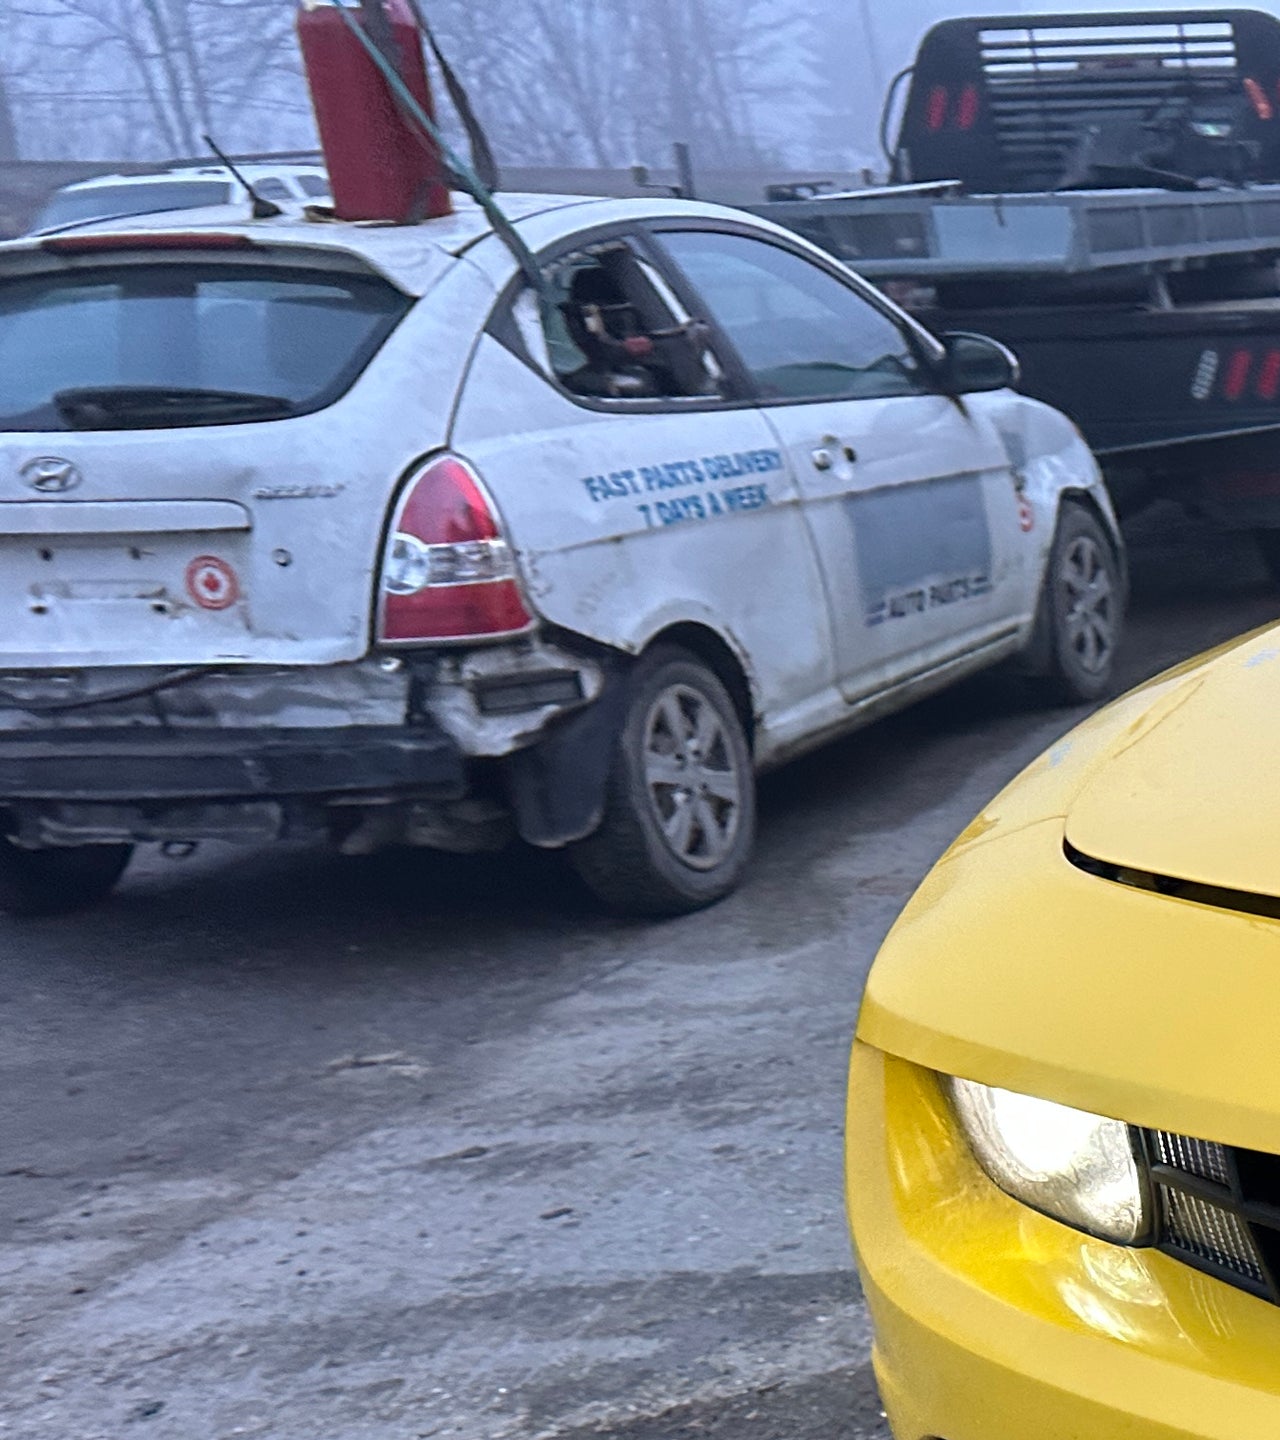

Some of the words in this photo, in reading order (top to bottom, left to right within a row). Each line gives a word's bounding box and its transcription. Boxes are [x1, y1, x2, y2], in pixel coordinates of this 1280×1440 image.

[583, 469, 641, 502] FAST
[637, 460, 706, 493] PARTS
[700, 448, 784, 482] DELIVERY
[637, 502, 653, 527] 7
[655, 494, 707, 526] DAYS
[706, 491, 724, 516] A
[721, 482, 768, 511] WEEK
